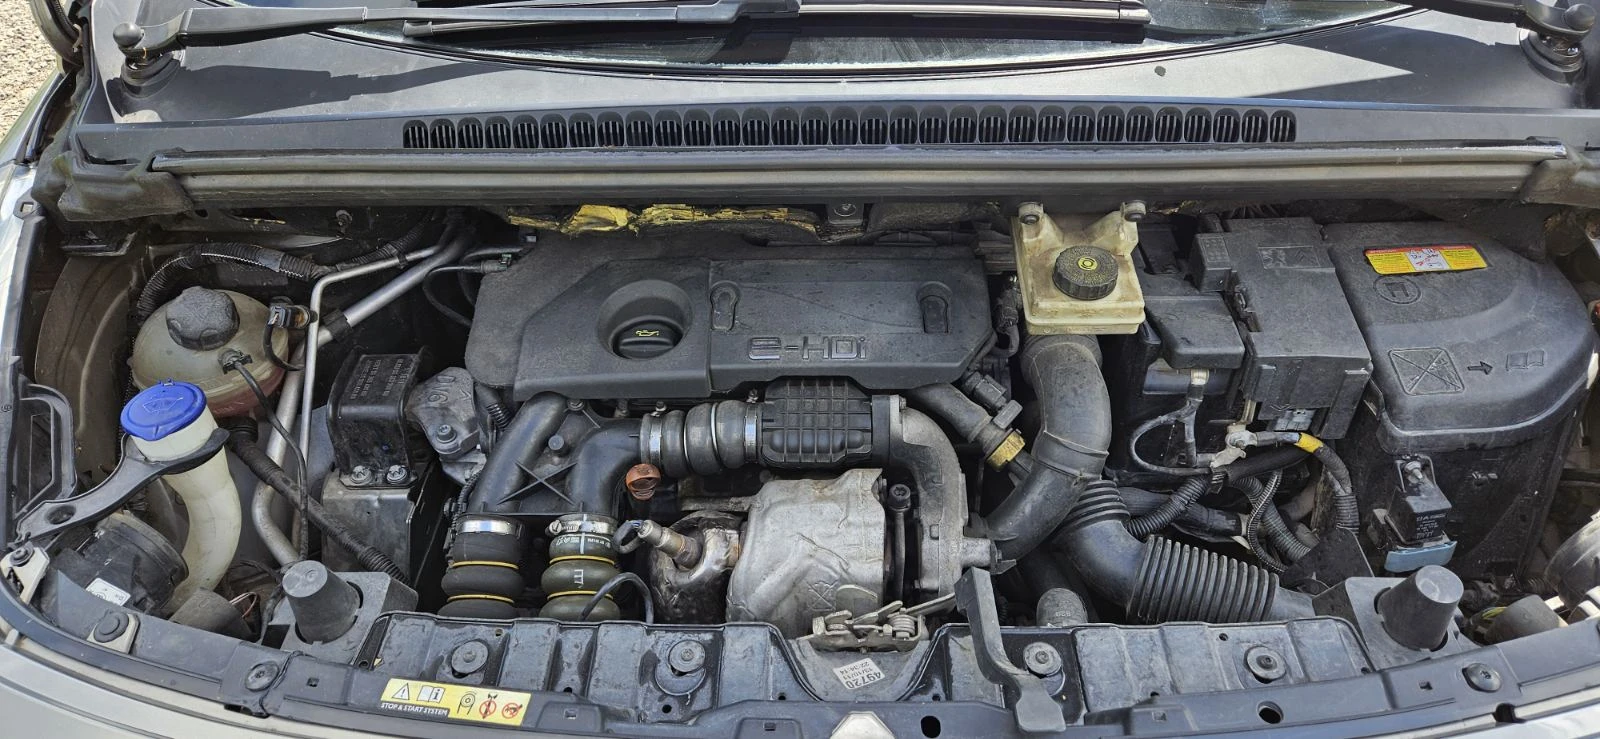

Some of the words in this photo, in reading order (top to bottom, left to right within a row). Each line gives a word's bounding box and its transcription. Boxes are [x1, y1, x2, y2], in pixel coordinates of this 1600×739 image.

[846, 672, 881, 688] 49720
[403, 704, 424, 713] START
[423, 708, 448, 716] SYSTEM
